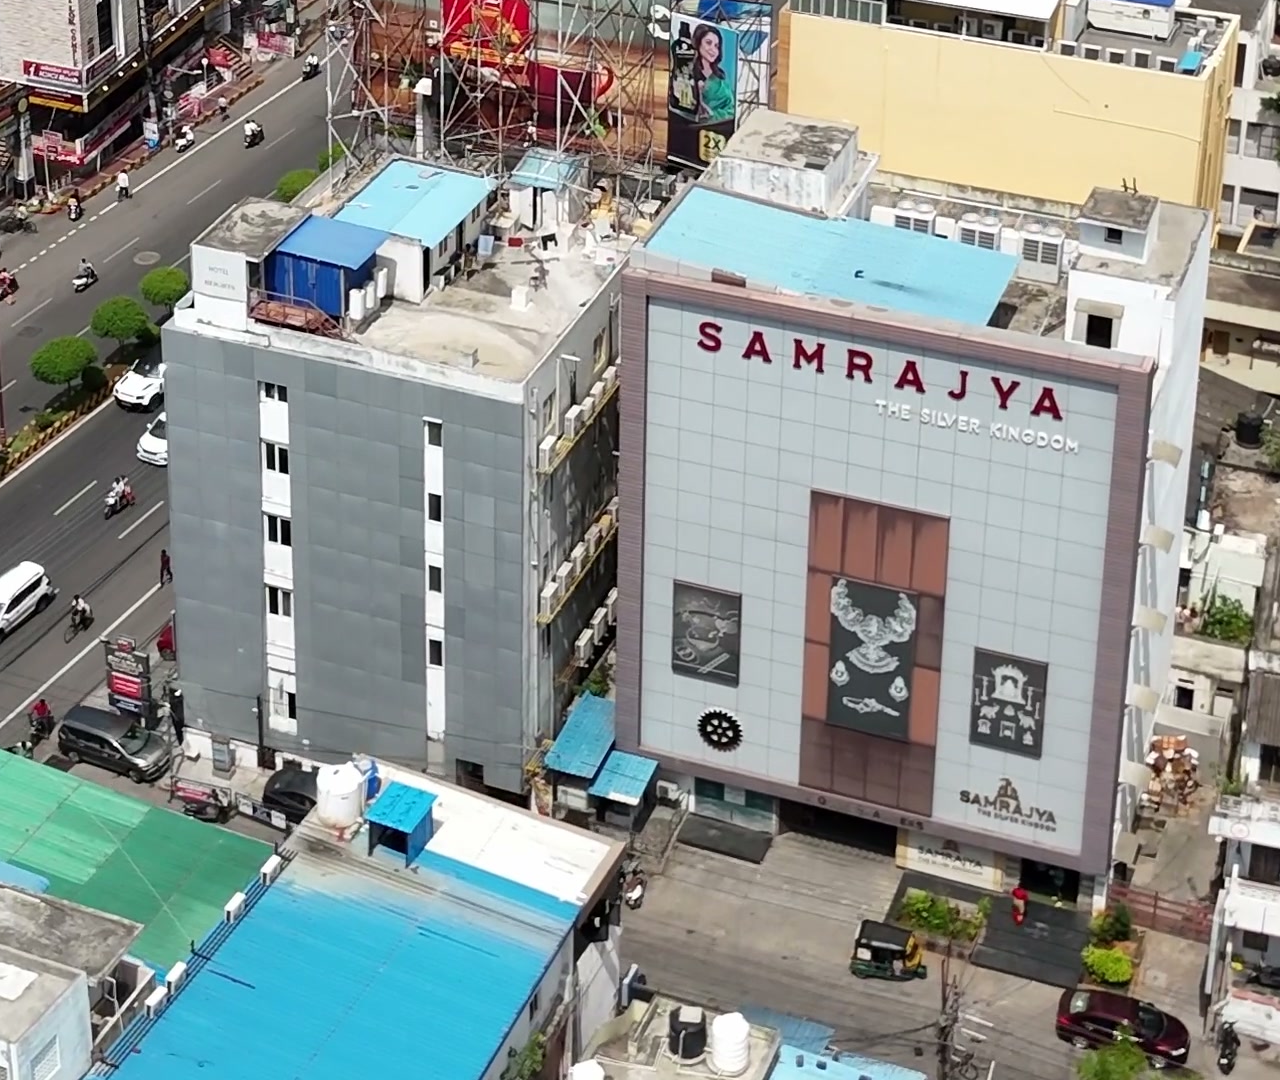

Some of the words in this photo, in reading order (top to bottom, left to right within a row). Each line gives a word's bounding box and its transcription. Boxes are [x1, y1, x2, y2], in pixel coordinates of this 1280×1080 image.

[38, 70, 59, 80] ICICI
[703, 135, 721, 151] 2X
[696, 321, 1064, 422] SAMRAJYA
[874, 399, 912, 421] THE
[919, 407, 981, 435] SILVER
[988, 422, 1080, 455] KINGDOM
[959, 789, 1057, 826] SAMRAJYA
